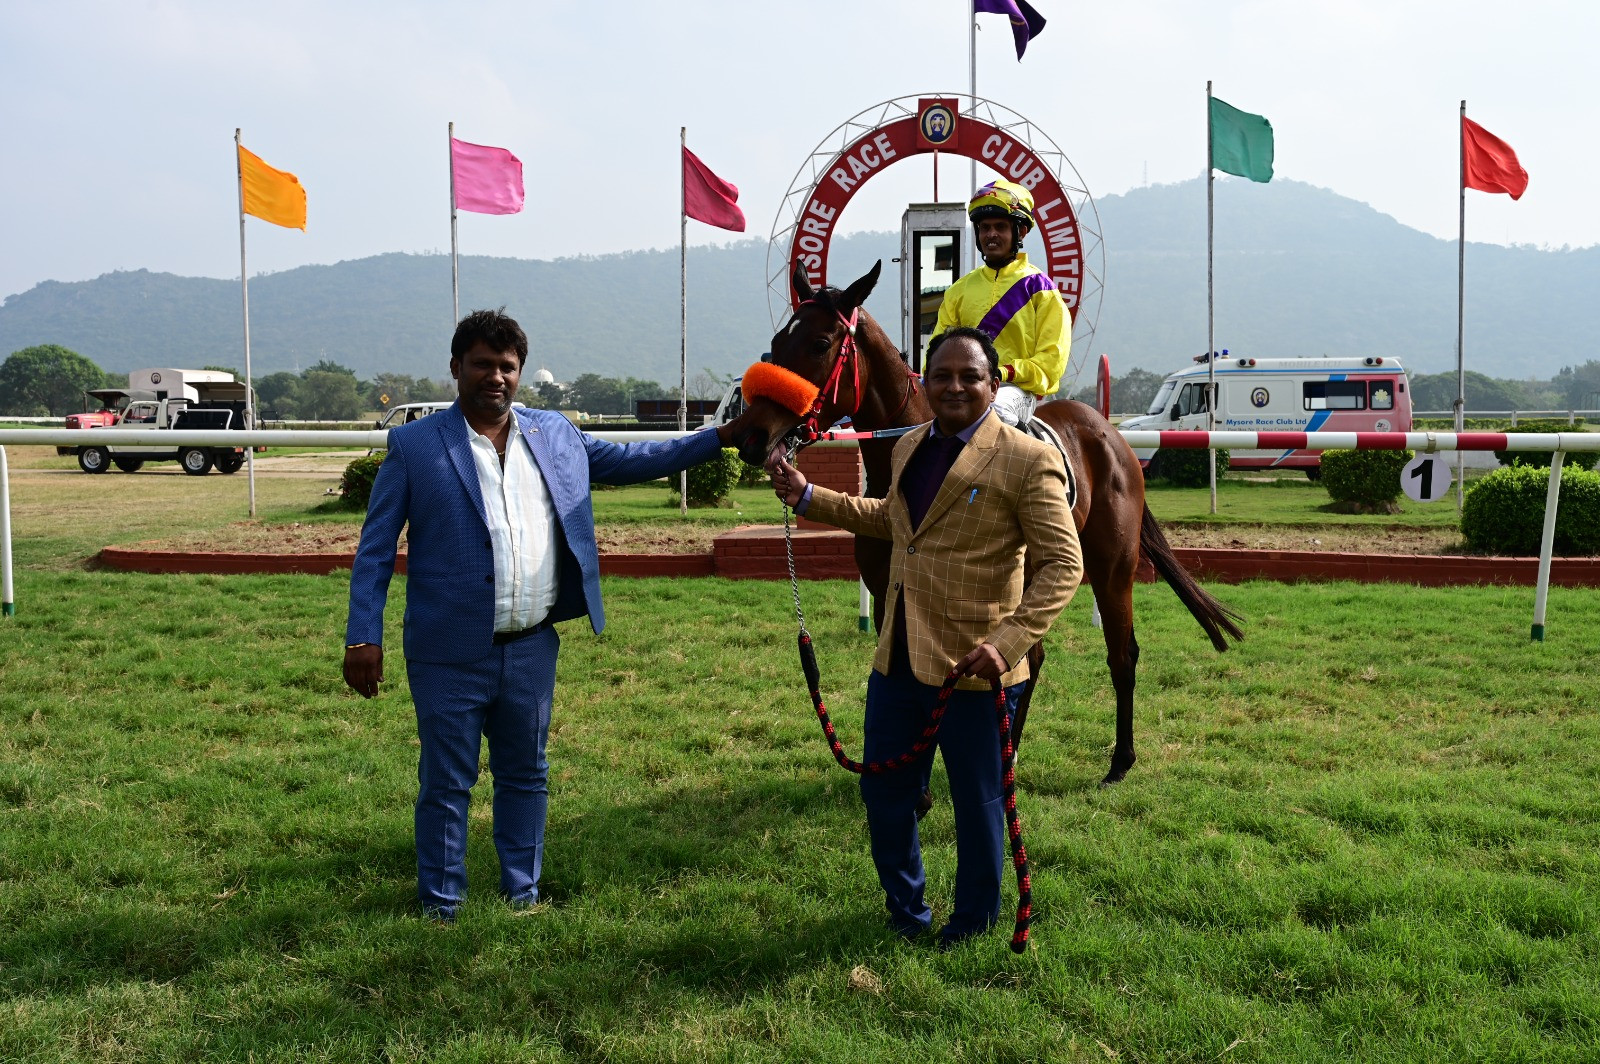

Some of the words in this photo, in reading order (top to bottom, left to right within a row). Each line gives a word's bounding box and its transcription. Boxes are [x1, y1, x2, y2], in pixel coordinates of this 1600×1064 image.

[797, 199, 836, 302] SORE
[830, 132, 897, 193] RACE
[981, 134, 1045, 191] CLUB
[1278, 360, 1321, 369] MOBILE
[1226, 418, 1253, 426] Mysore
[1411, 459, 1434, 500] 1
